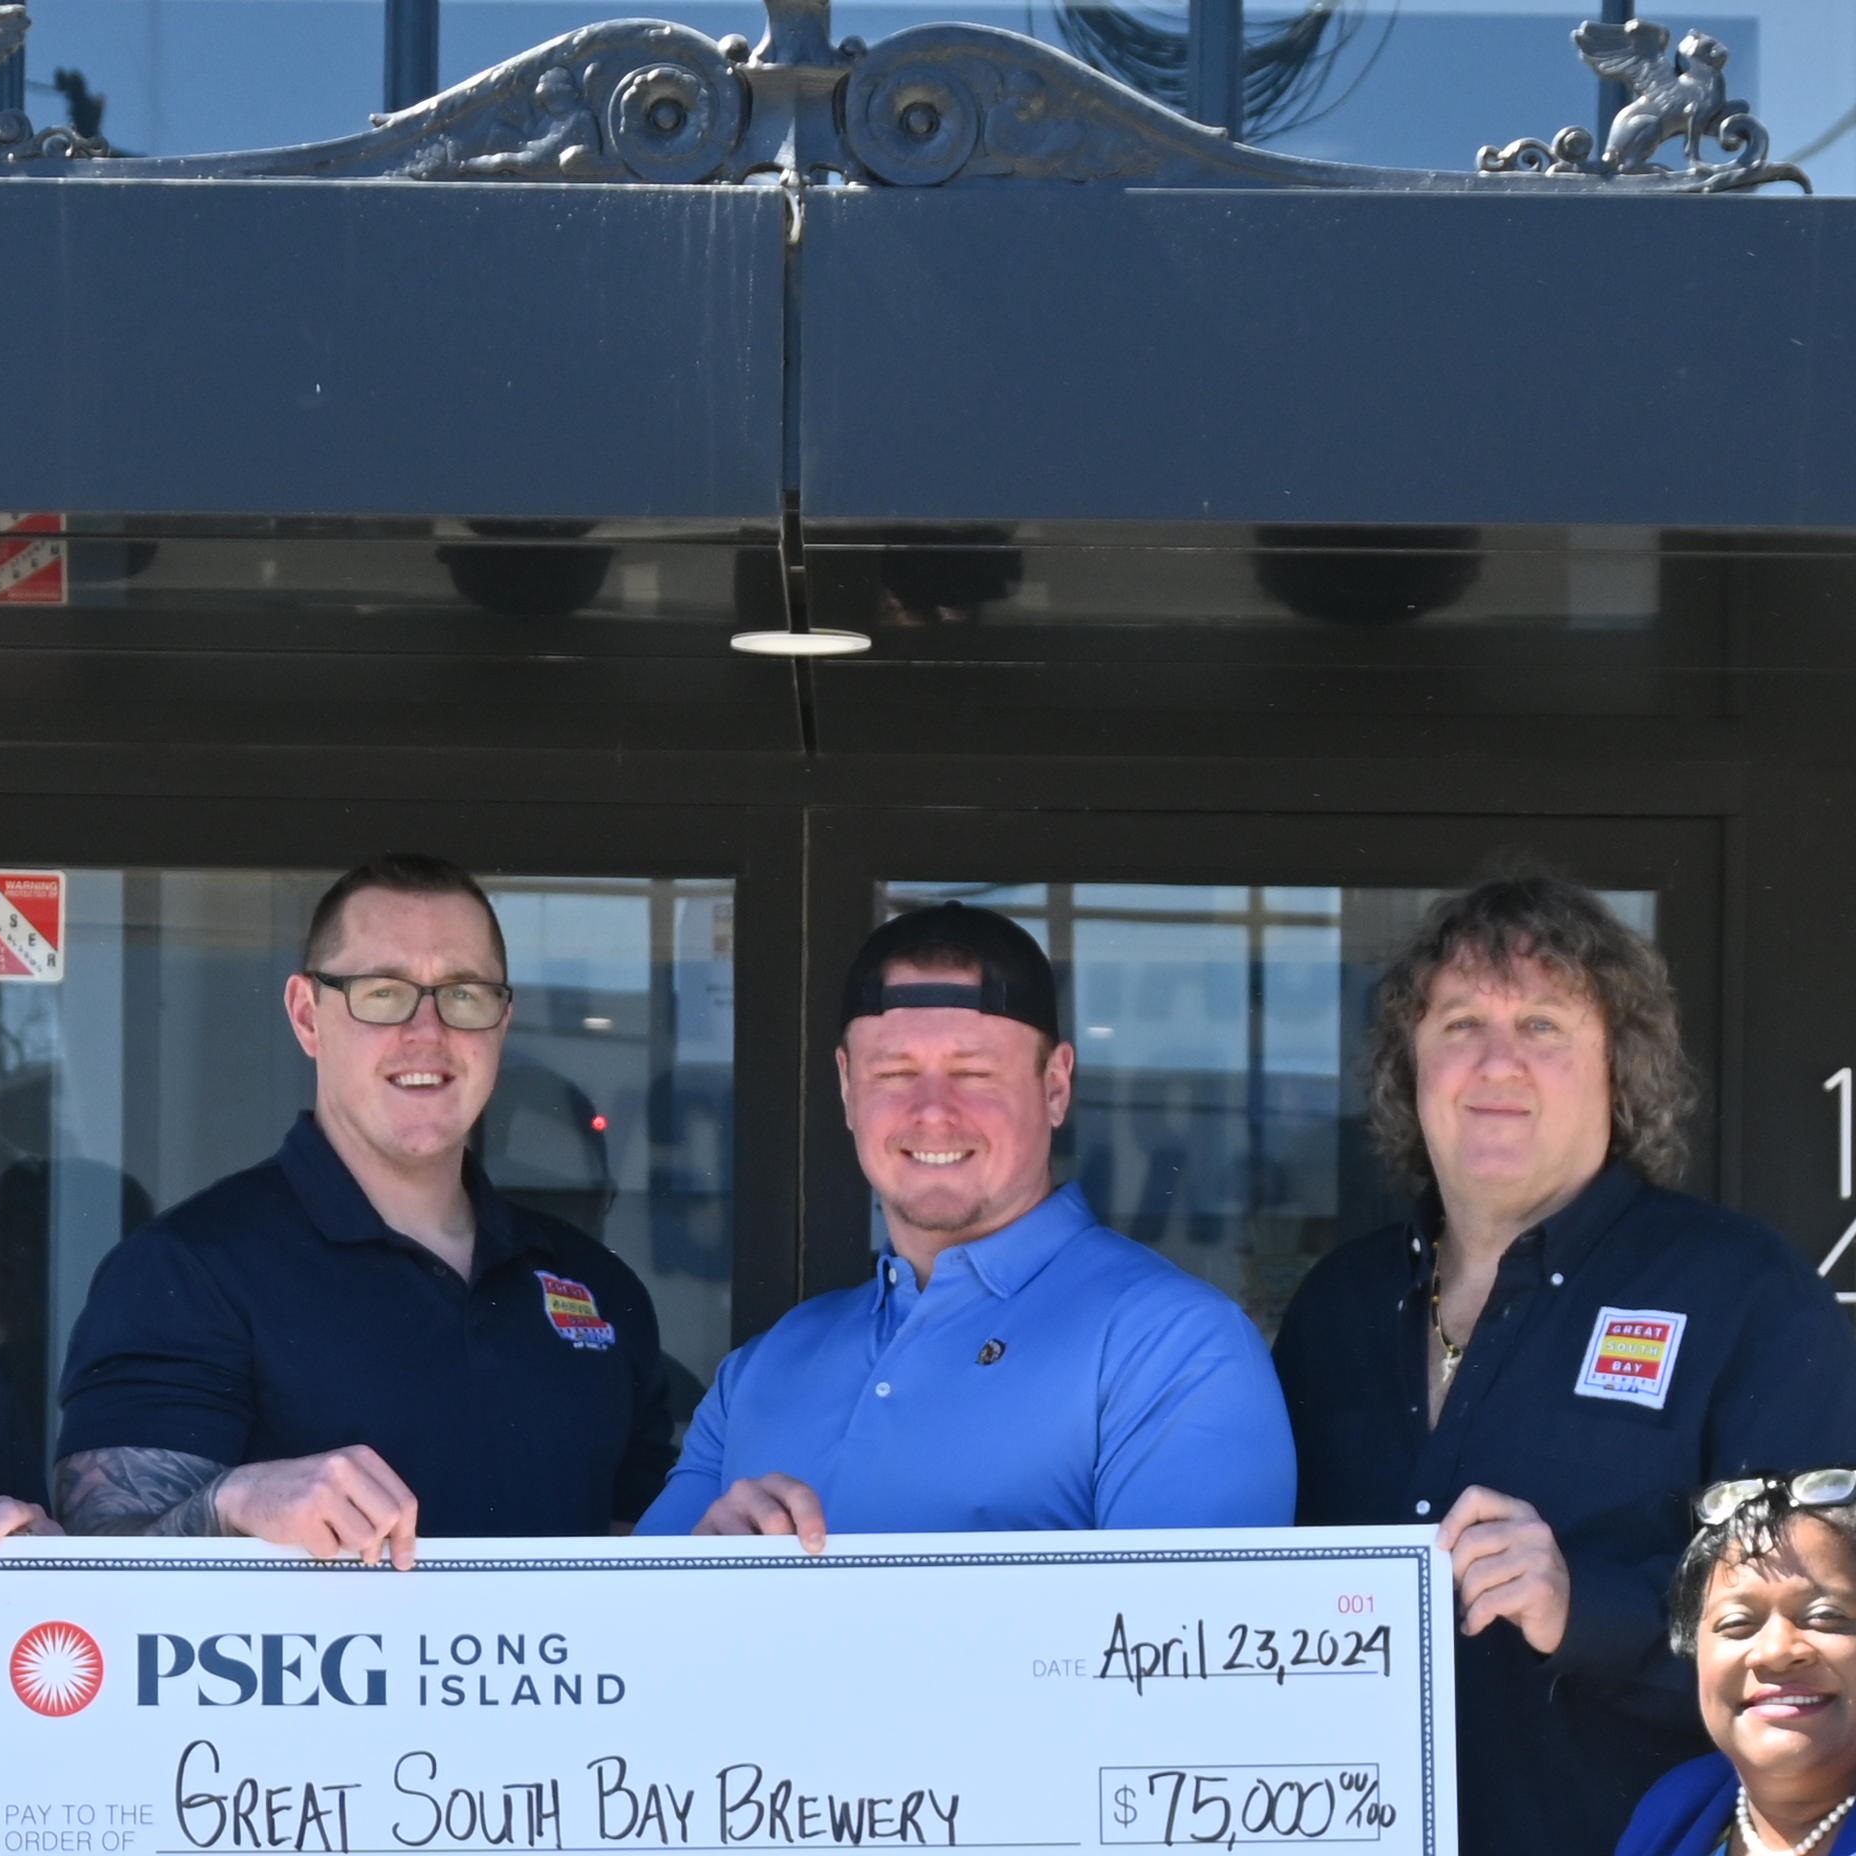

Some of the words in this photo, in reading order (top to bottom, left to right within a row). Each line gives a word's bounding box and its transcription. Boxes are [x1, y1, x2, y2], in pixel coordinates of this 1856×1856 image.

[1612, 1325, 1663, 1338] GREAT
[1607, 1341, 1658, 1356] SOUTH
[1612, 1361, 1642, 1373] BAY
[1337, 1594, 1374, 1614] 001
[419, 1632, 570, 1666] LONG
[1101, 1612, 1207, 1696] April
[136, 1632, 388, 1707] PSEG
[1032, 1658, 1086, 1678] DATE
[419, 1673, 626, 1707] ISLAND
[176, 1740, 362, 1853] GREAT
[392, 1751, 562, 1849] SOUTH
[587, 1756, 694, 1845] BAY
[716, 1763, 959, 1846] BREWERY
[5, 1804, 51, 1825] PAY
[61, 1804, 96, 1825] TO
[105, 1804, 153, 1825] THE
[5, 1831, 92, 1852] ORDER
[101, 1831, 135, 1852] OF
